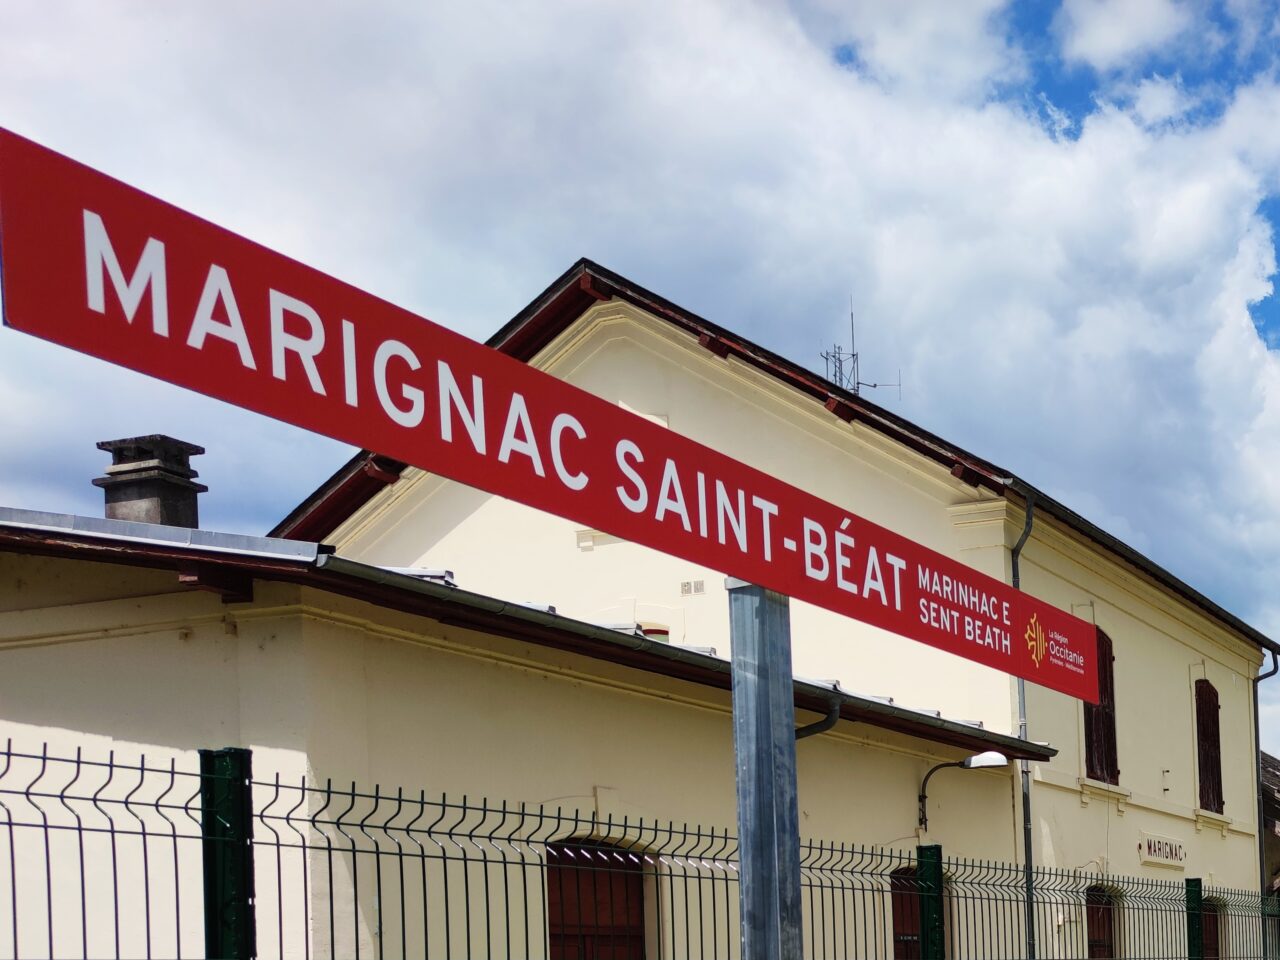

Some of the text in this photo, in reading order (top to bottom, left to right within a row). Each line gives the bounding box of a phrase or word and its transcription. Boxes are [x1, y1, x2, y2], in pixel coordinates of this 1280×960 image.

[83, 208, 907, 611] MARIGNAC SAINT-BÉAT
[918, 563, 1011, 626] MARINHAC E
[919, 598, 1011, 656] SENT BEATH
[1049, 640, 1084, 666] Occitanie
[1147, 838, 1183, 862] MARIGNAC
